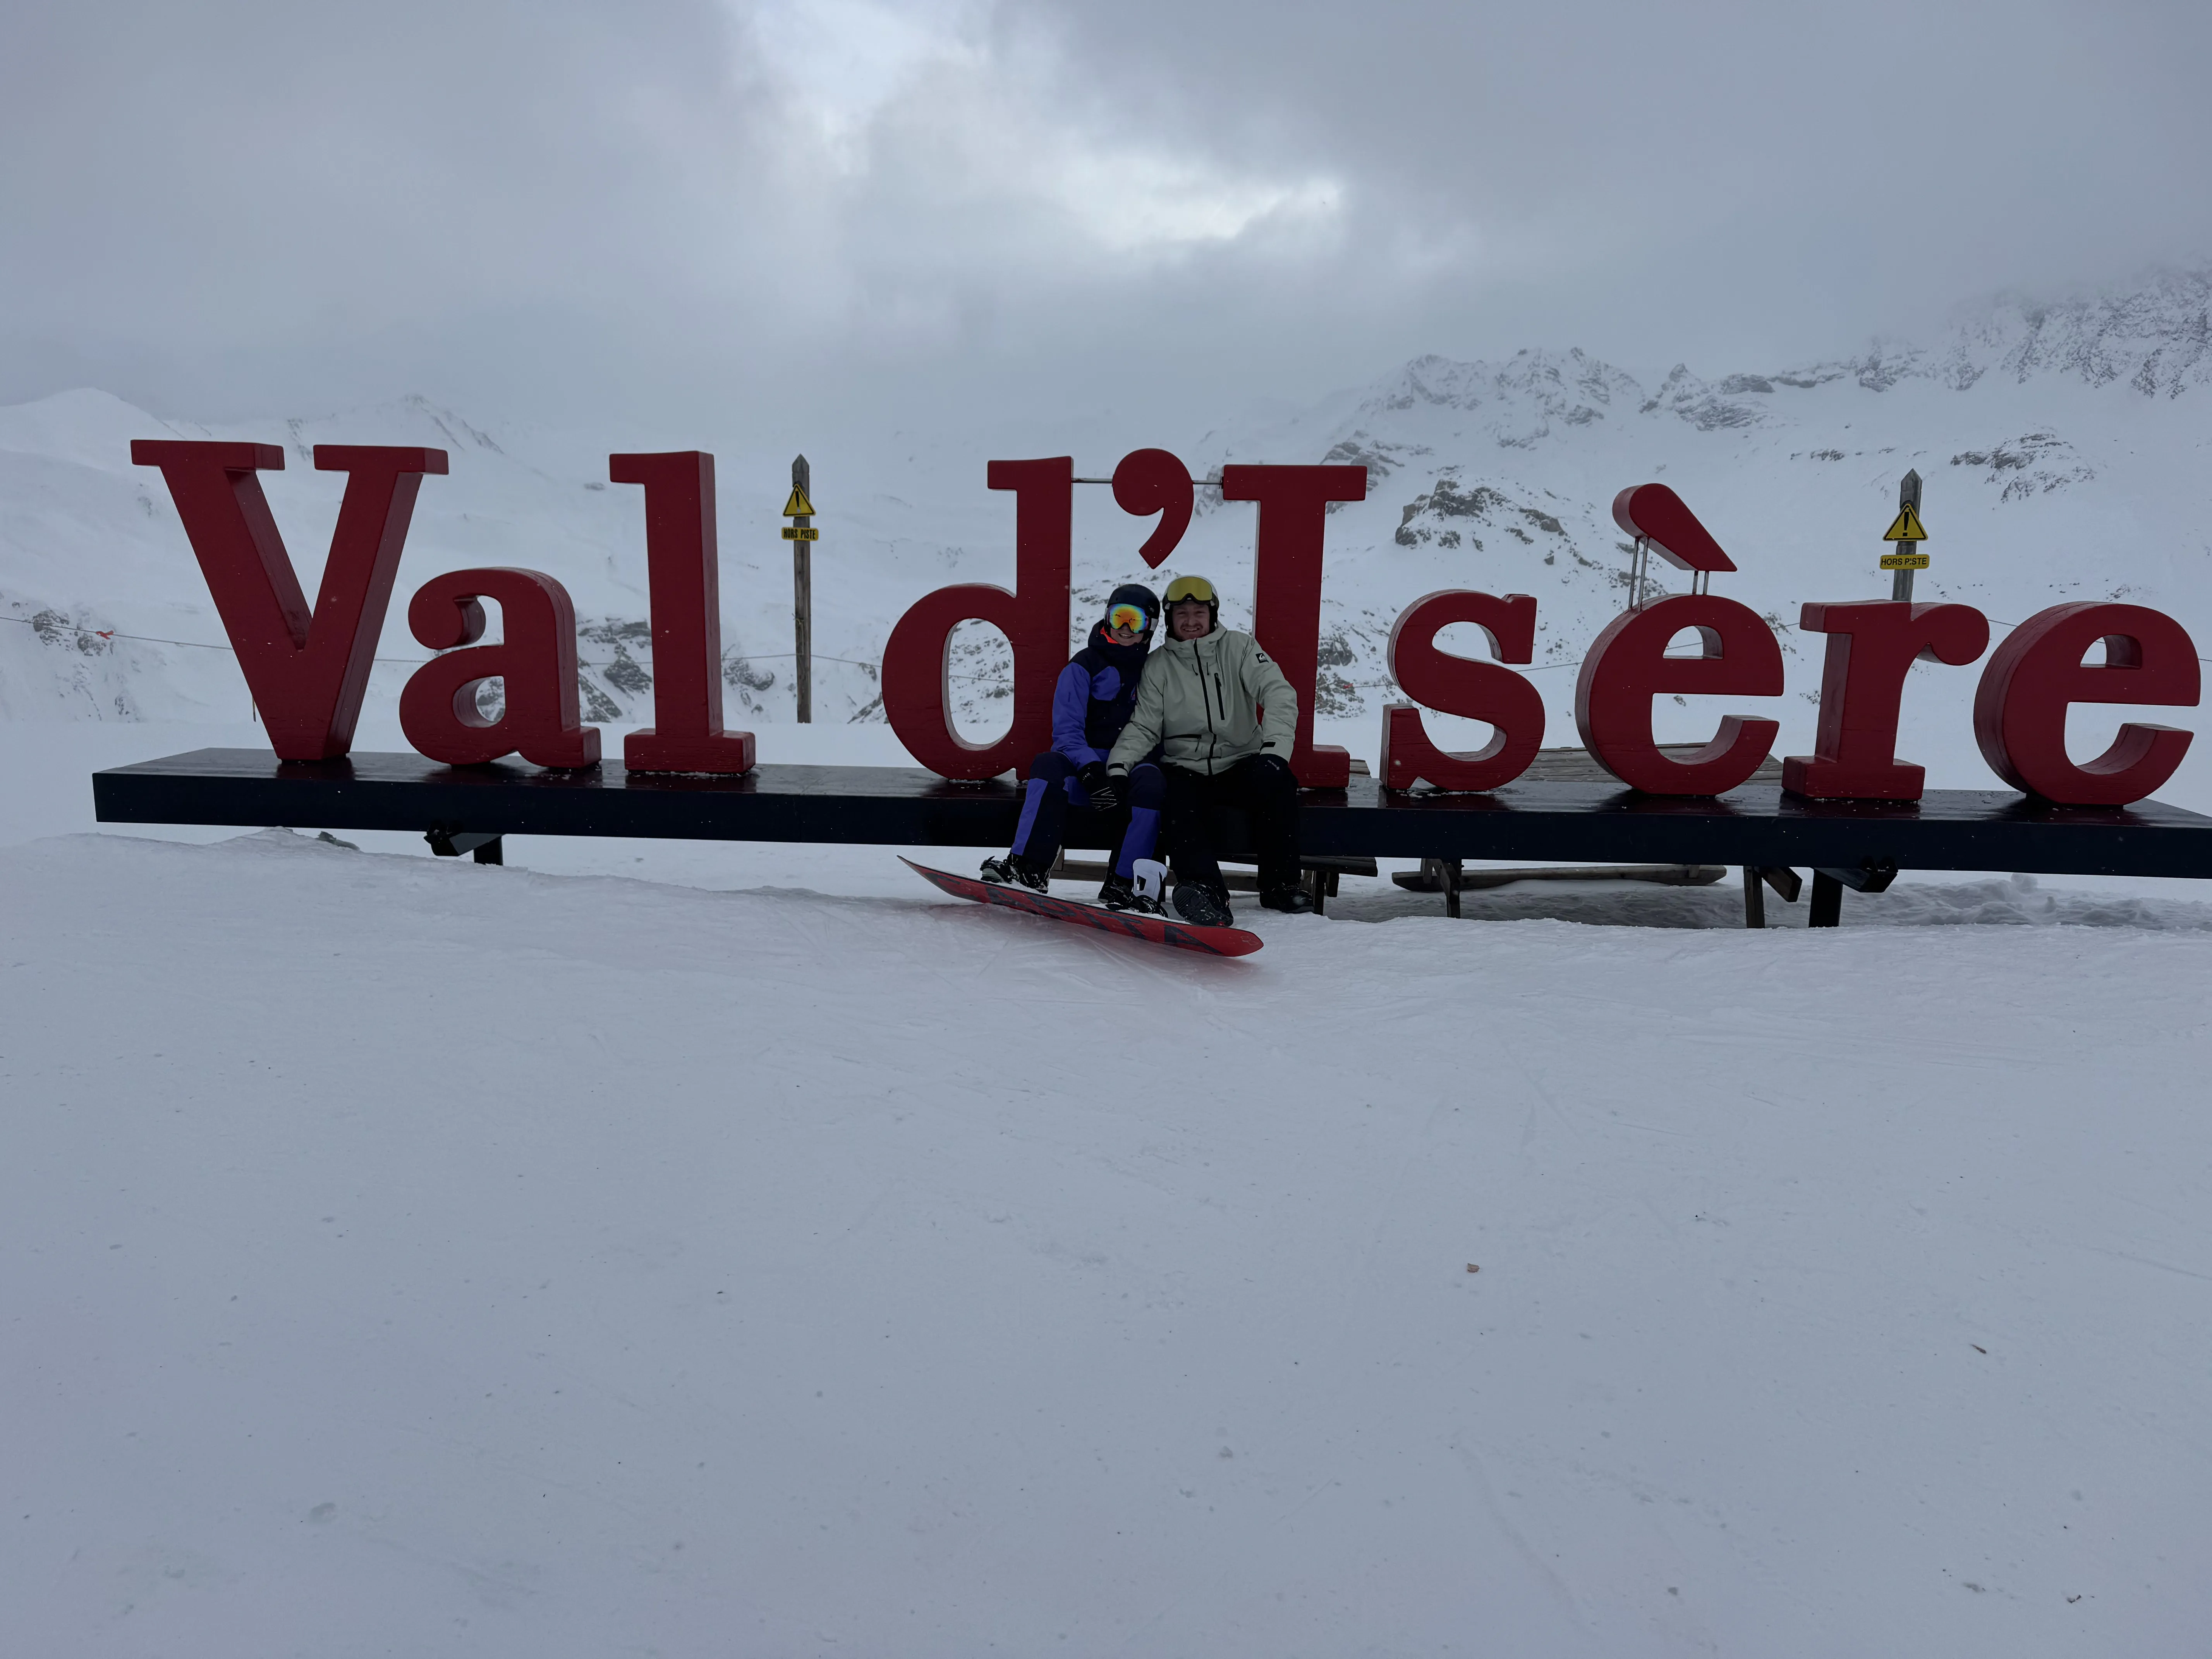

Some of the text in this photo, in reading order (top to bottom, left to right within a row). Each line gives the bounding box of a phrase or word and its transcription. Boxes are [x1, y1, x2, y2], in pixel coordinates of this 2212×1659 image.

[131, 440, 756, 773] Val
[784, 528, 816, 539] HORS PISTE
